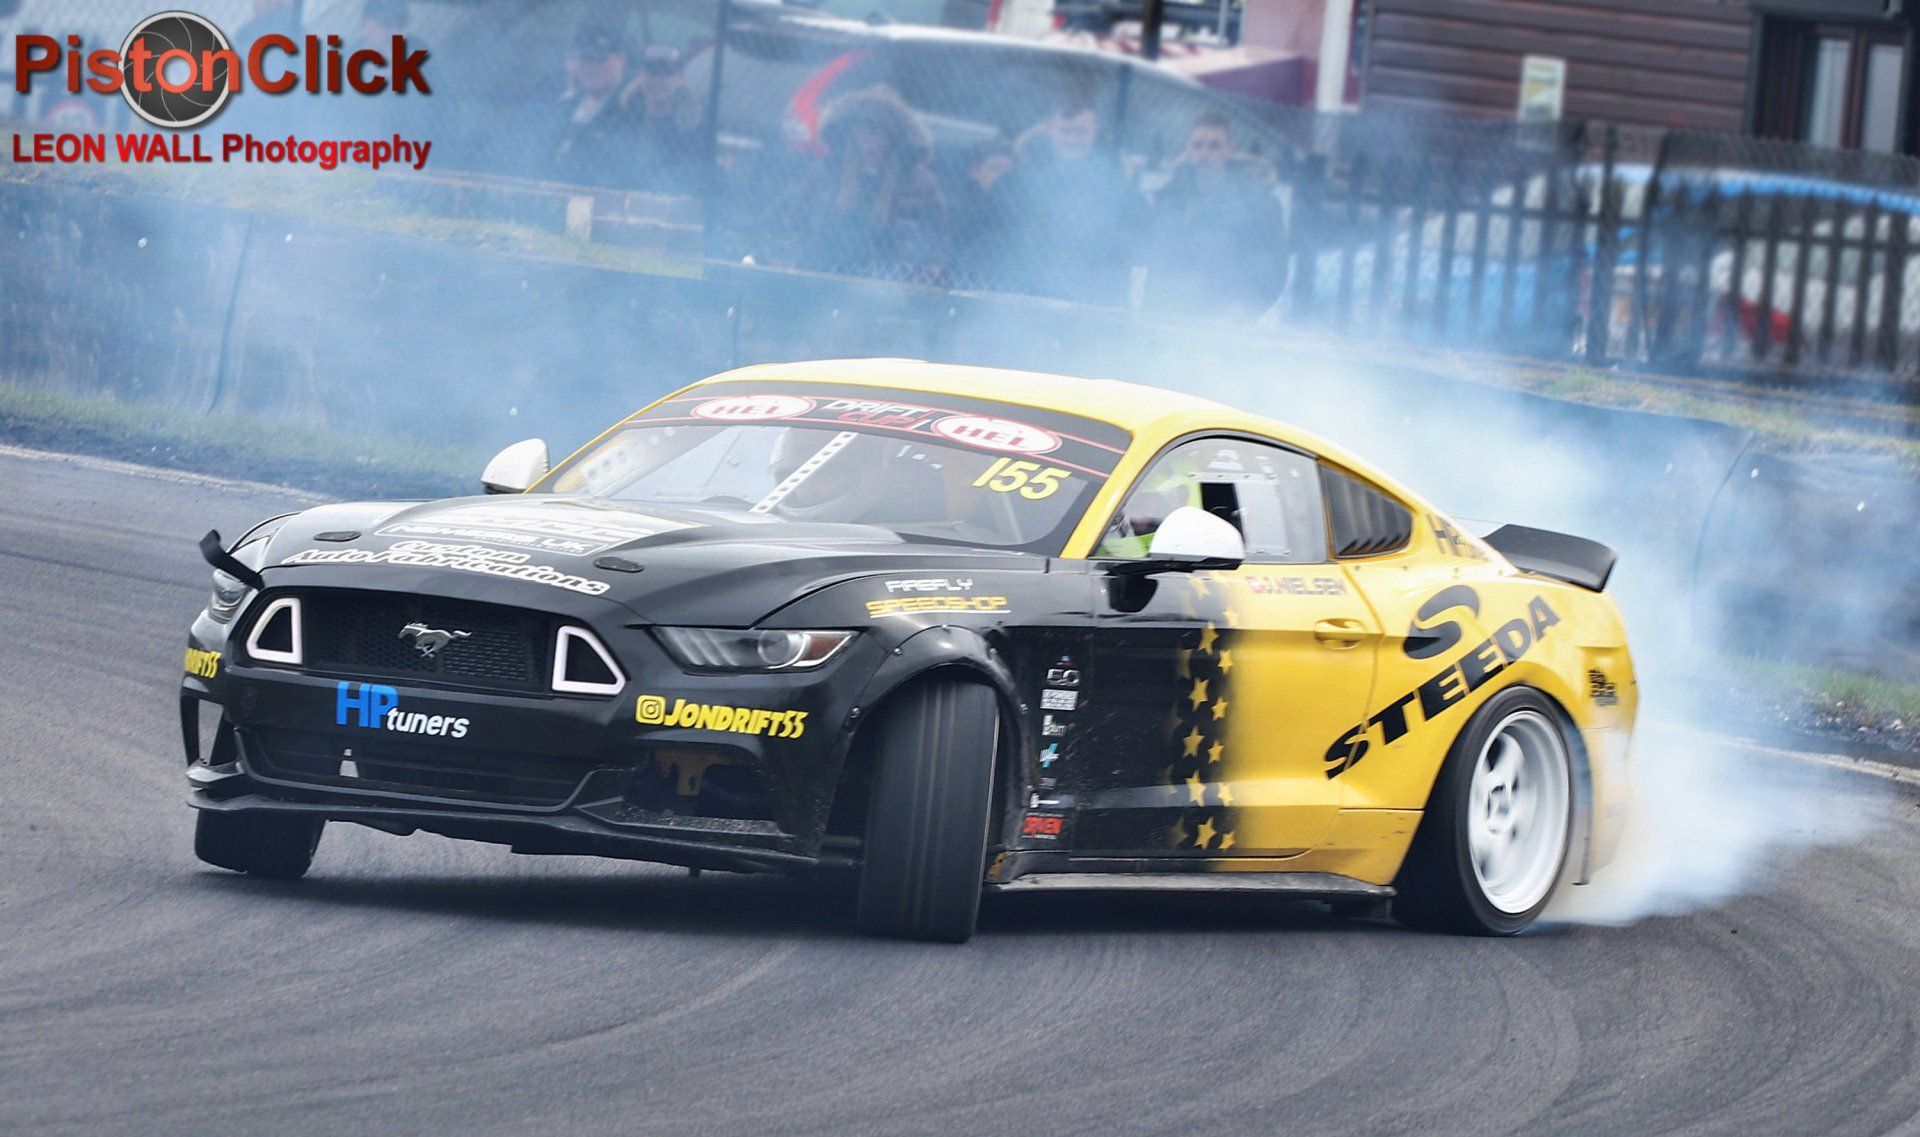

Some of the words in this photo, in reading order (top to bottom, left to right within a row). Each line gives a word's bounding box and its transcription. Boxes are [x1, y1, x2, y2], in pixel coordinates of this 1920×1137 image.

[823, 400, 931, 419] DRIFT
[952, 424, 1028, 449] HEL
[971, 457, 1072, 500] 155
[389, 540, 532, 565] Custom
[865, 596, 1008, 615] SPEEDSHOP
[1324, 595, 1561, 781] STEEDA
[336, 681, 398, 729] HP
[387, 707, 470, 738] tuners
